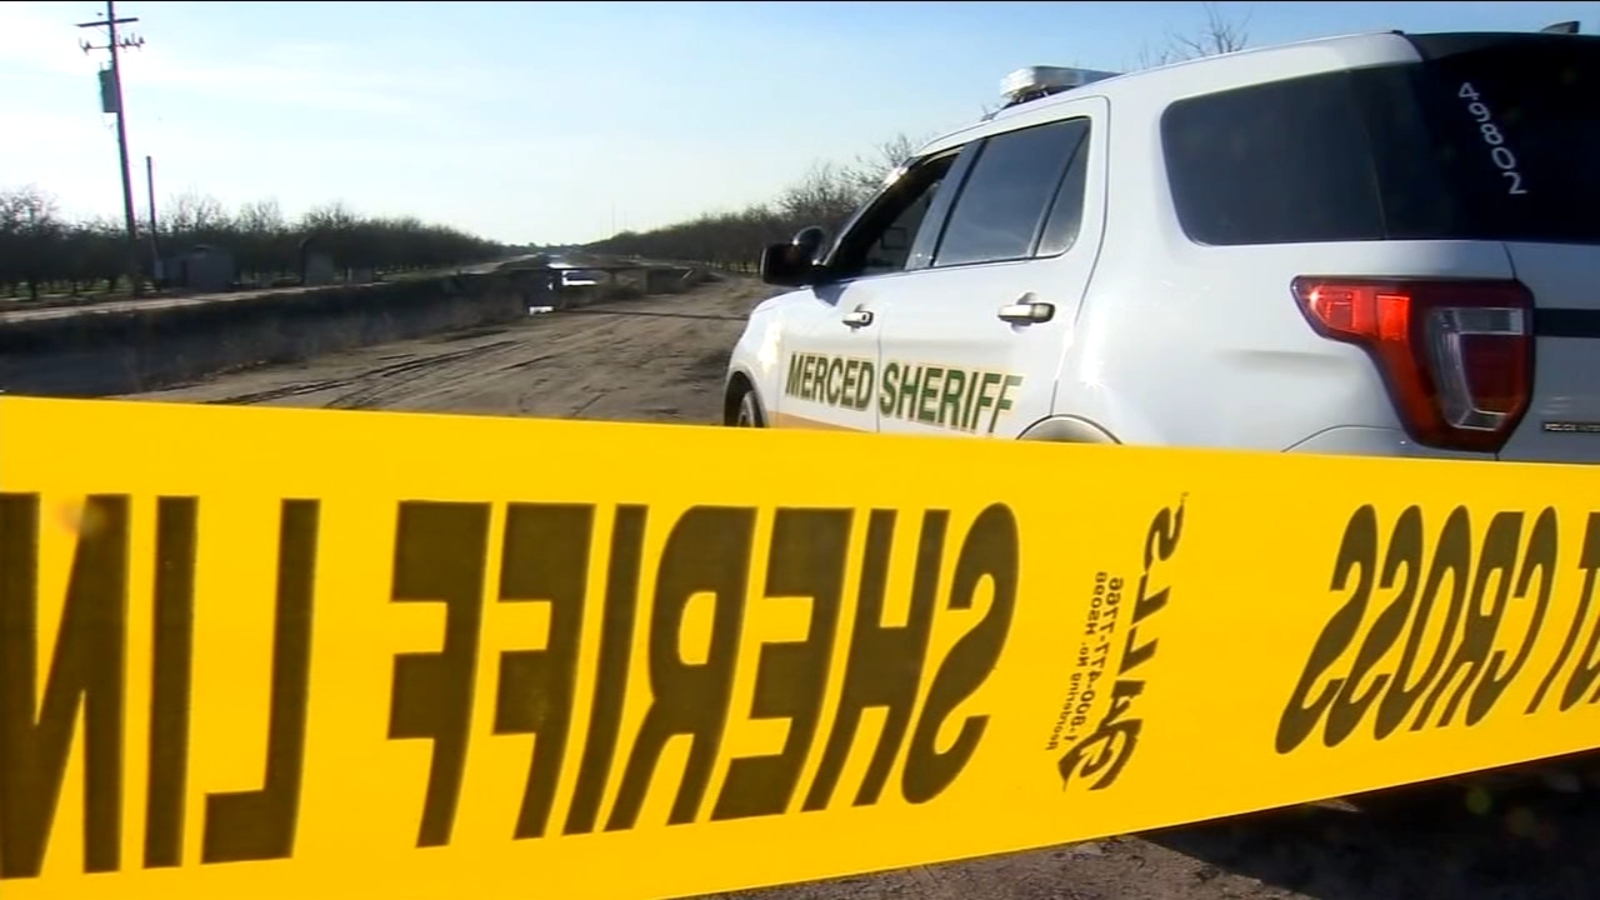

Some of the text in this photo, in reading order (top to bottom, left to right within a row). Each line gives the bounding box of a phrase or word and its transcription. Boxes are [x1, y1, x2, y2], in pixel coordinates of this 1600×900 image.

[1458, 82, 1528, 194] 49802
[785, 353, 1024, 434] MERCED SHERIFF
